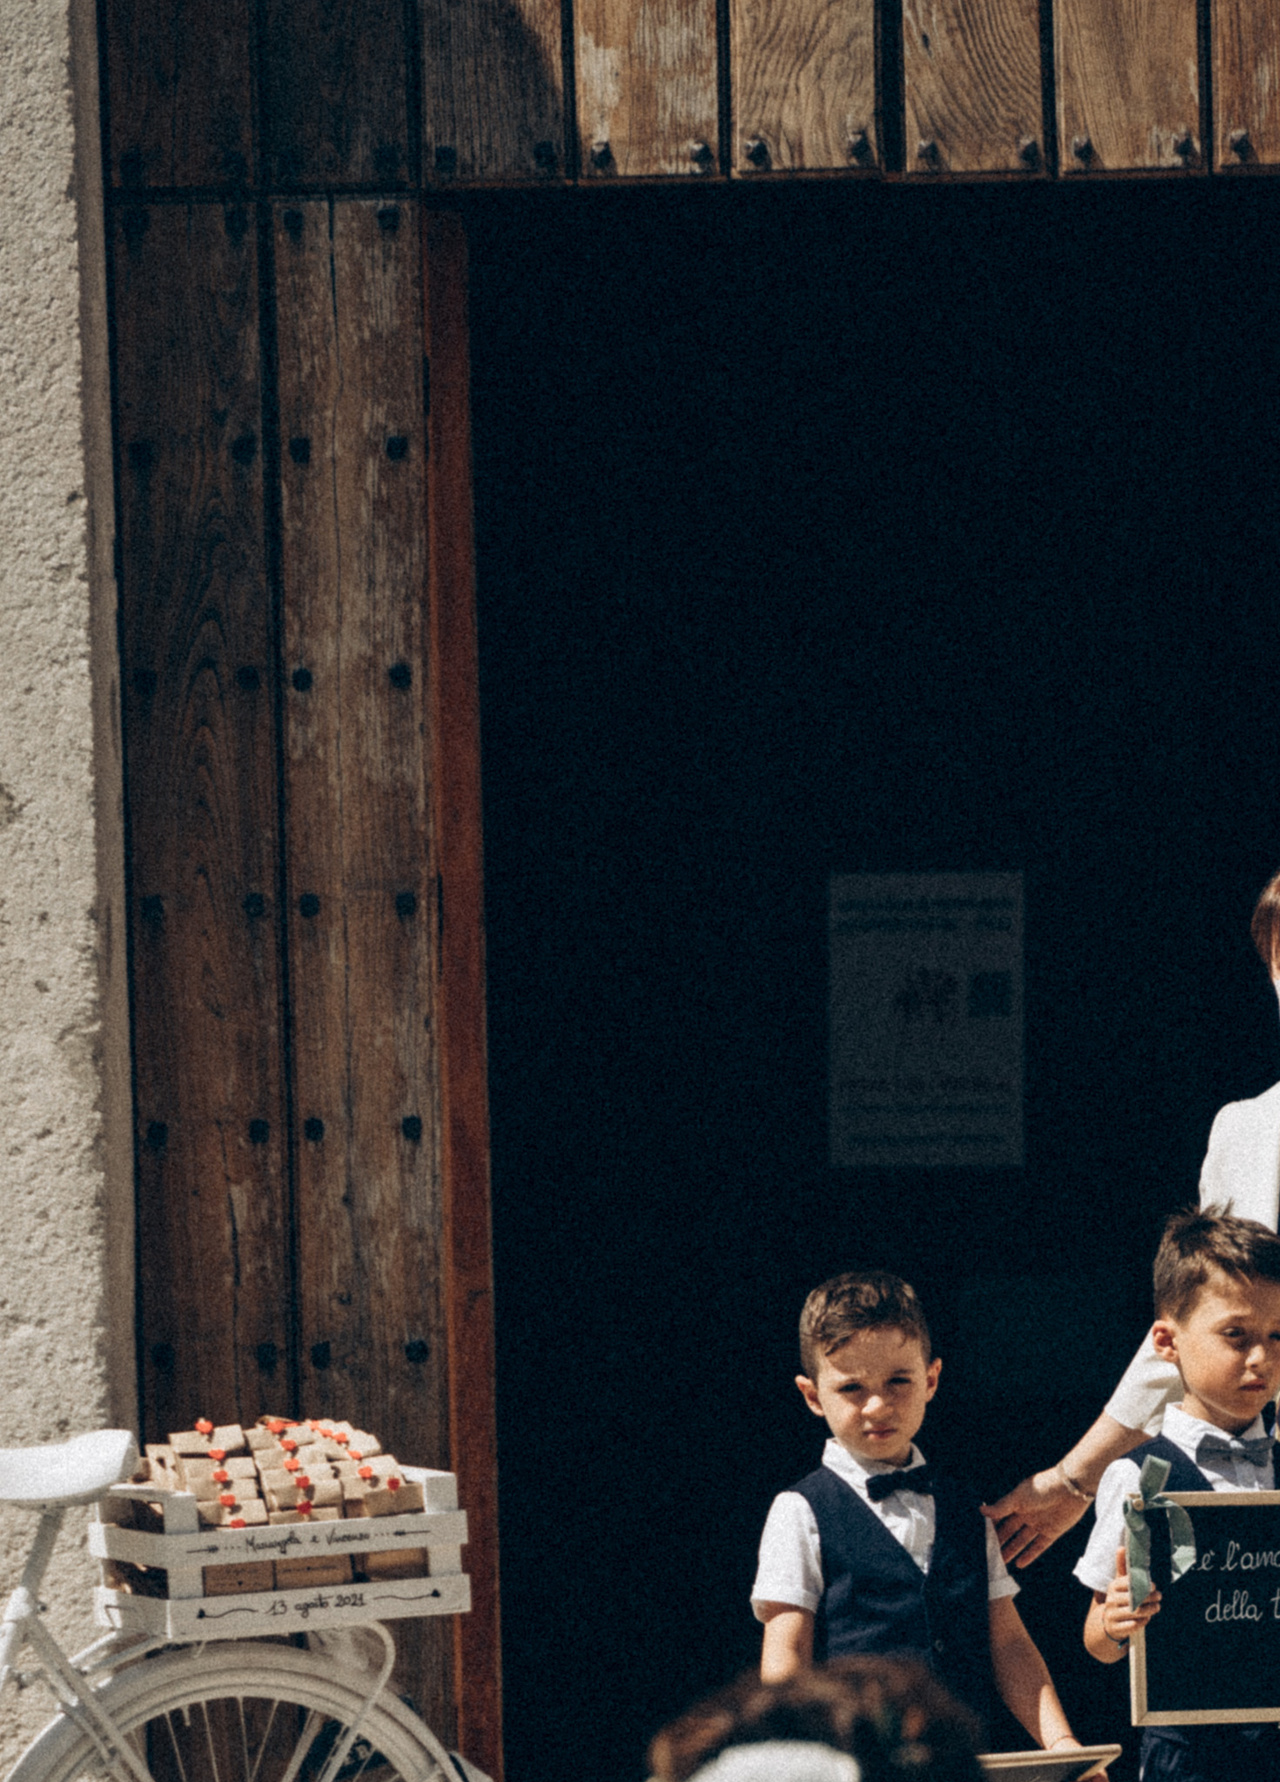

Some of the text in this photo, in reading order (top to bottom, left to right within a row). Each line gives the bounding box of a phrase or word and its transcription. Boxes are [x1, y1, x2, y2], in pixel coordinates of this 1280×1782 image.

[265, 1593, 367, 1618] 13 agosto 2021
[1205, 1588, 1263, 1623] della
